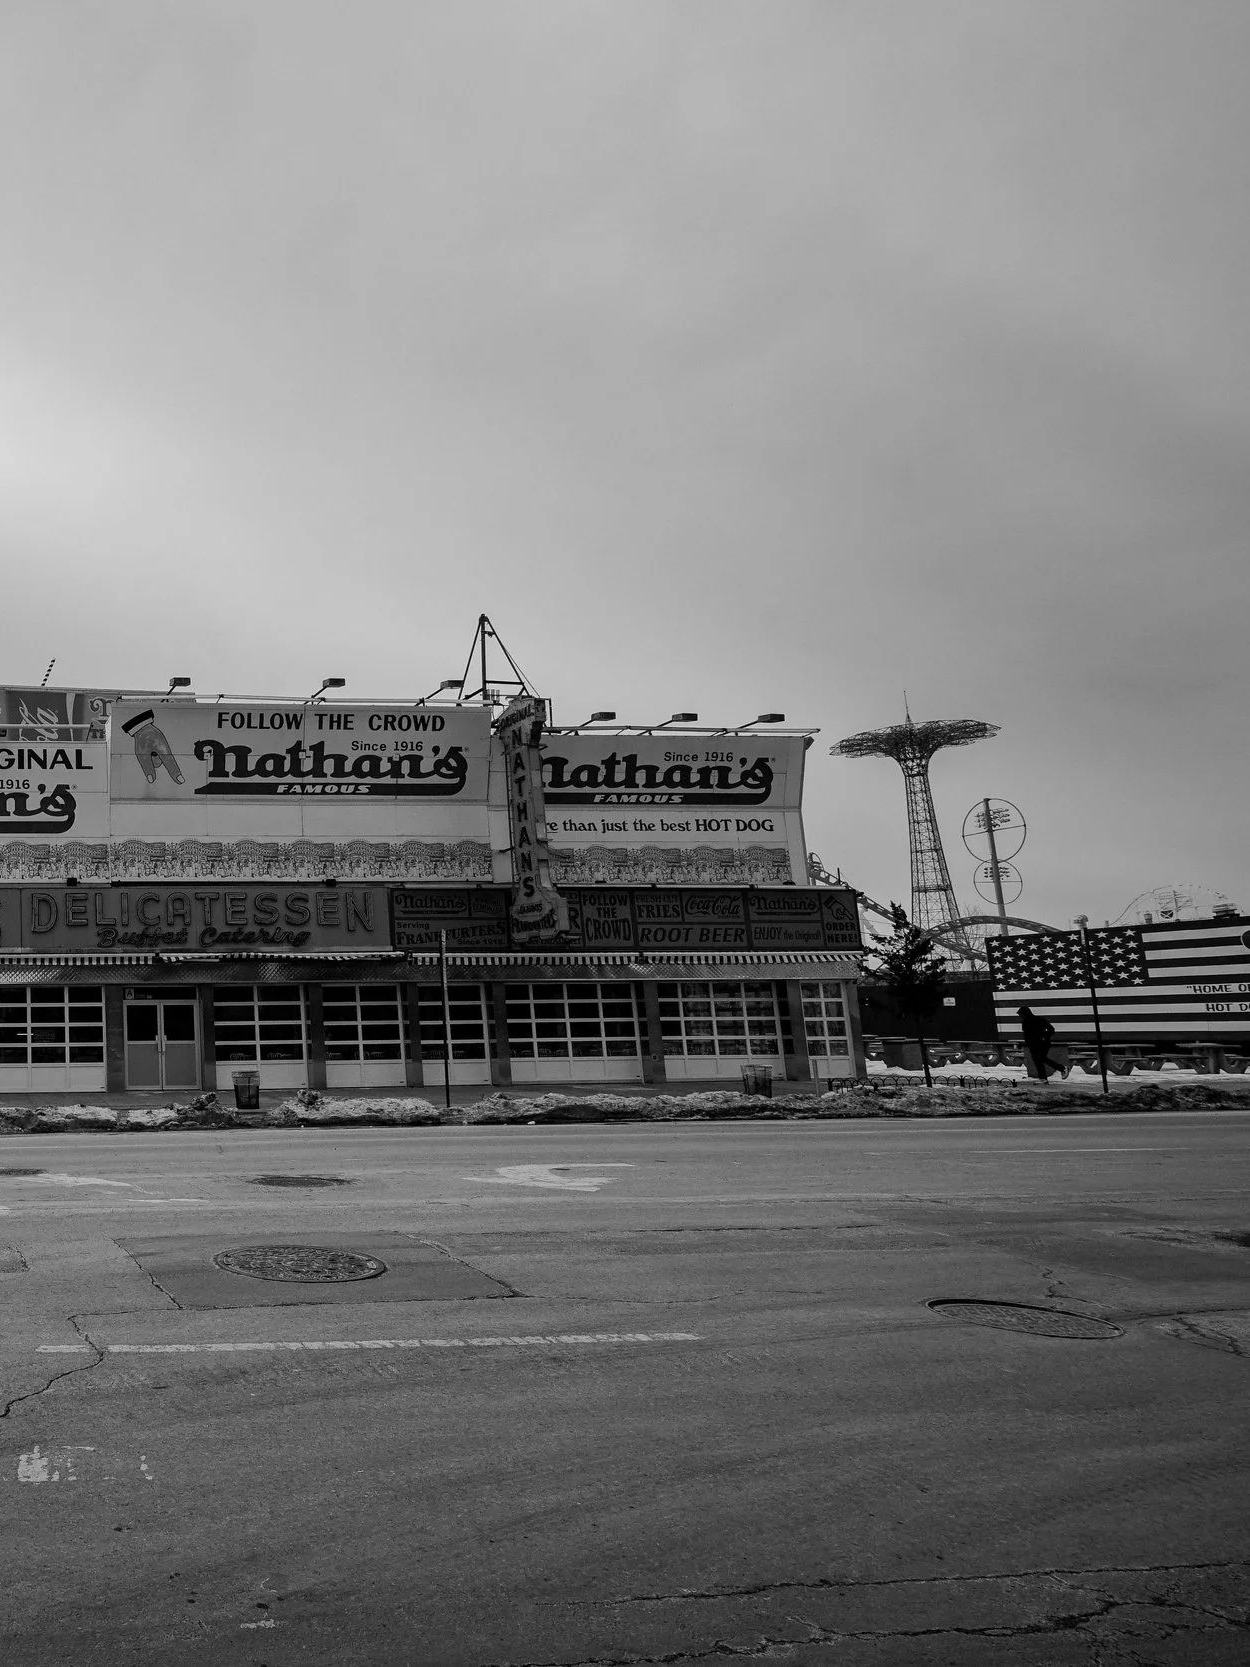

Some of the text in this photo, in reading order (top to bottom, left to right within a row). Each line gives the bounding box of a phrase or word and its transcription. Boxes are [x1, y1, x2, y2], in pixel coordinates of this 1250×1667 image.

[217, 712, 445, 732] FOLLOW THE CROWD
[351, 740, 423, 752] Since 1916
[194, 739, 469, 780] Nathan's
[663, 751, 734, 763] Since 1916
[276, 784, 371, 794] FAMOUS
[593, 794, 684, 804] FAMOUS
[562, 818, 598, 832] than
[600, 819, 629, 834] just
[633, 818, 656, 832] the
[660, 818, 692, 833] best
[694, 818, 732, 832] HOT
[735, 818, 774, 833] DOG
[582, 894, 628, 906] FOLLOW
[30, 892, 375, 934] DELICATESSEN
[597, 907, 617, 918] THE
[636, 904, 681, 918] FRIES
[397, 921, 430, 930] Serving
[585, 917, 632, 941] CROWD
[826, 921, 856, 932] ORDER
[199, 926, 311, 948] Catering
[640, 927, 745, 943] ROOT BEER
[754, 926, 782, 940] ENJOY
[827, 933, 858, 943] HERE!
[1206, 1003, 1231, 1012] HOT
